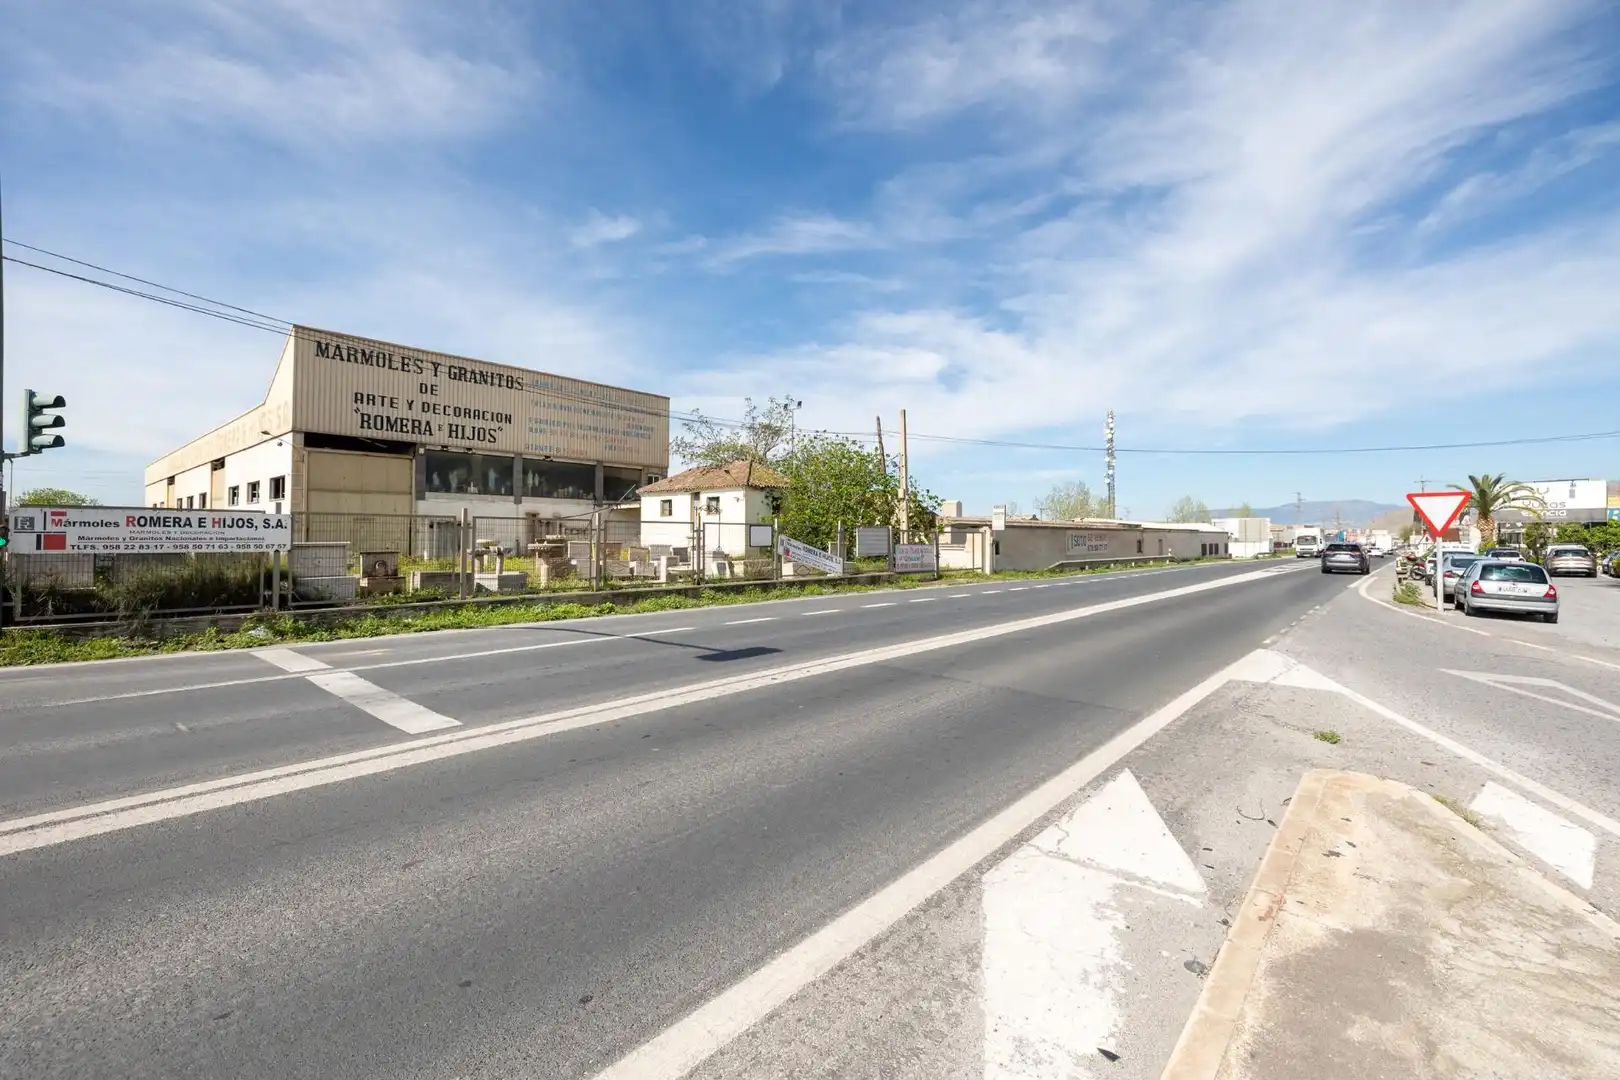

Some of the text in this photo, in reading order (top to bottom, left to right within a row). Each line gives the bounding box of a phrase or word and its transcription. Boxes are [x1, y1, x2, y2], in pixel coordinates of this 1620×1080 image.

[315, 340, 424, 375] MARMOLES
[431, 361, 441, 378] Y
[447, 364, 524, 391] GRANITOS
[419, 382, 439, 397] DE
[354, 391, 399, 410] ARTE
[406, 399, 415, 411] Y
[421, 401, 512, 425] DECORACION
[437, 423, 444, 432] E
[1520, 509, 1567, 518] encia
[50, 515, 288, 531] Mármoles ROMERA E HIJOS, S.A.
